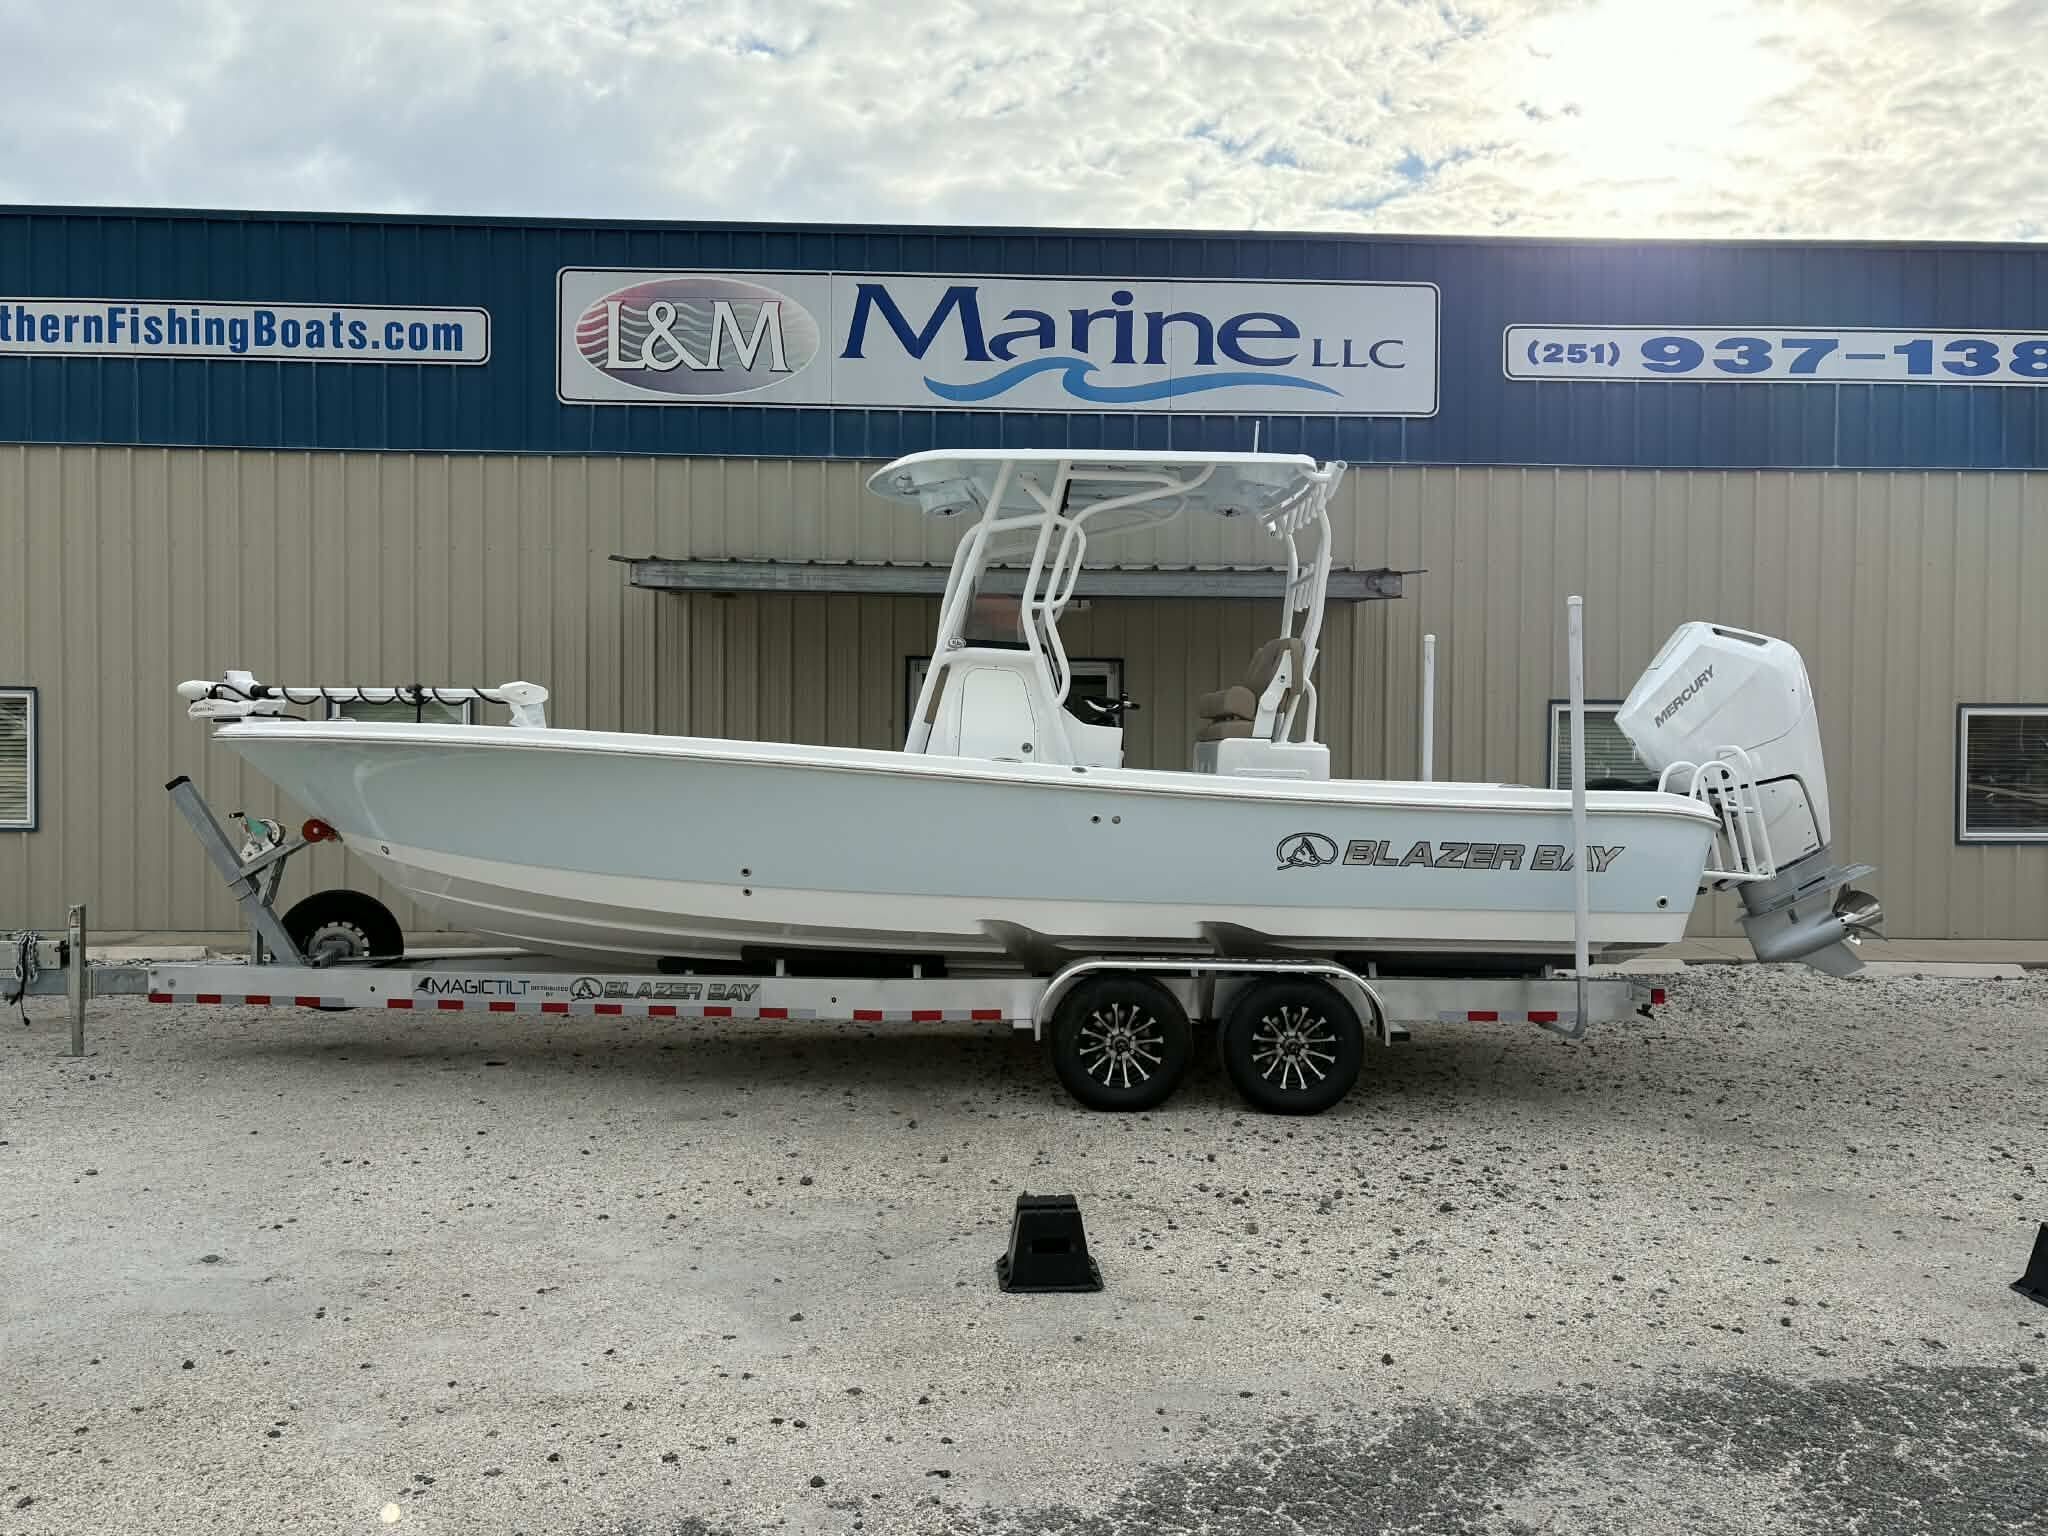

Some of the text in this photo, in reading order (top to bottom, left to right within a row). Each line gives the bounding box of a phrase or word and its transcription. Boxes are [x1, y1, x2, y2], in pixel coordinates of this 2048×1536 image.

[604, 283, 1406, 373] L&M Marine LLC
[1527, 339, 1621, 367] (251)
[1654, 664, 1715, 729] MERCURY
[1342, 839, 1525, 871] BLAZER
[431, 978, 531, 995] MAGICTILT
[603, 981, 761, 1002] BLAZER BAY
